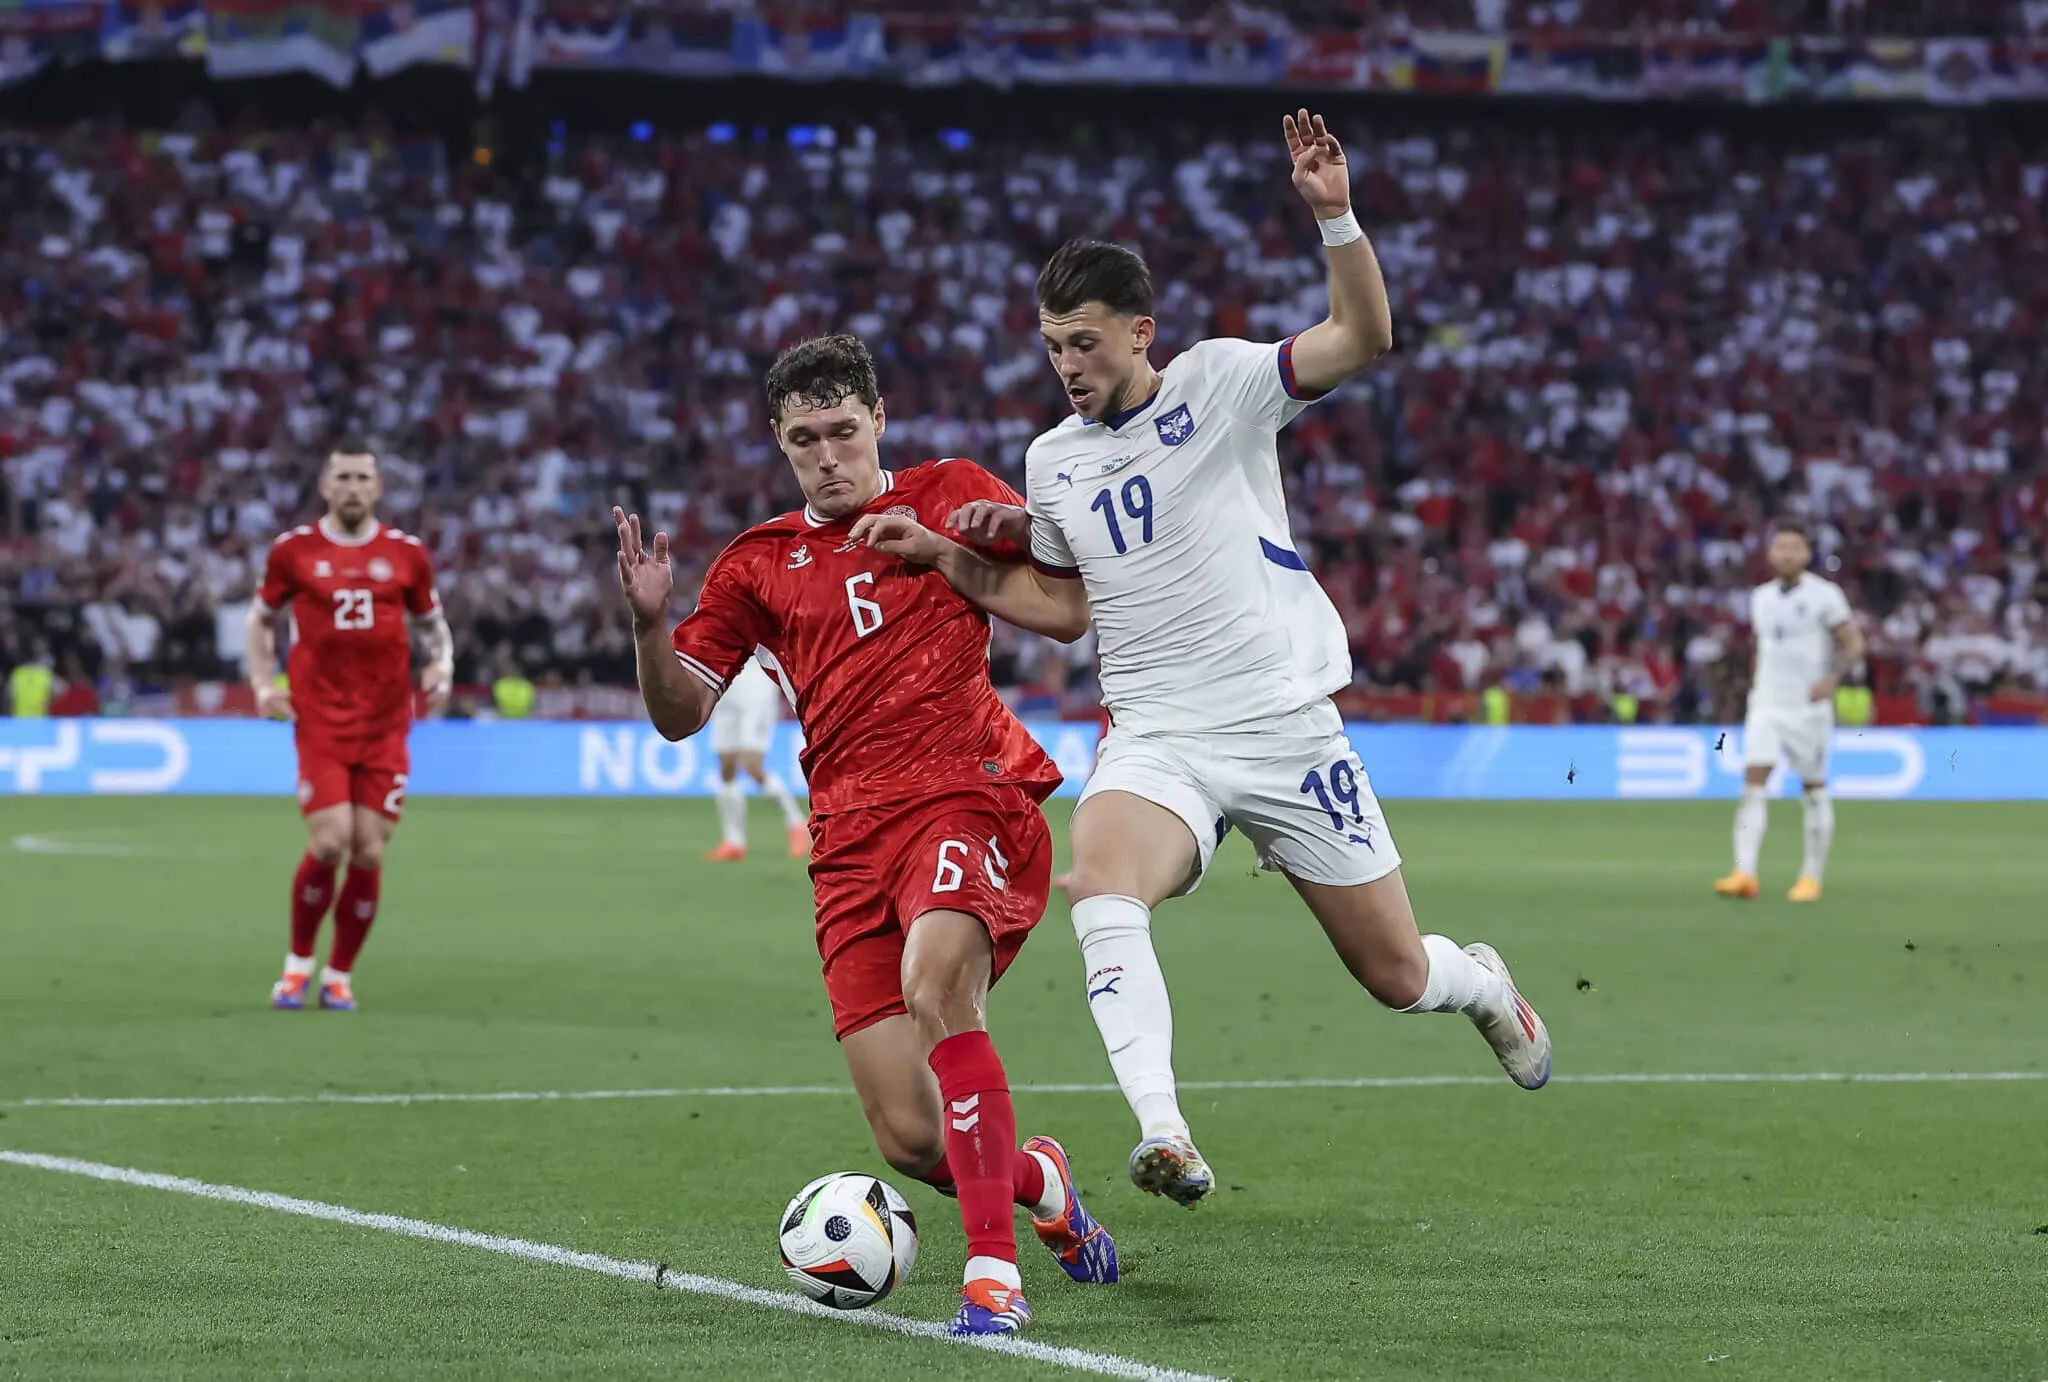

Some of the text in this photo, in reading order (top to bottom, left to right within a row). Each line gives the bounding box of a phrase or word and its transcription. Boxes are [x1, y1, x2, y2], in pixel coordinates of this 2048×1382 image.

[1090, 475, 1154, 555] 19
[332, 588, 375, 630] 23
[844, 571, 884, 638] 6
[1300, 759, 1364, 831] 19
[931, 839, 969, 894] 6
